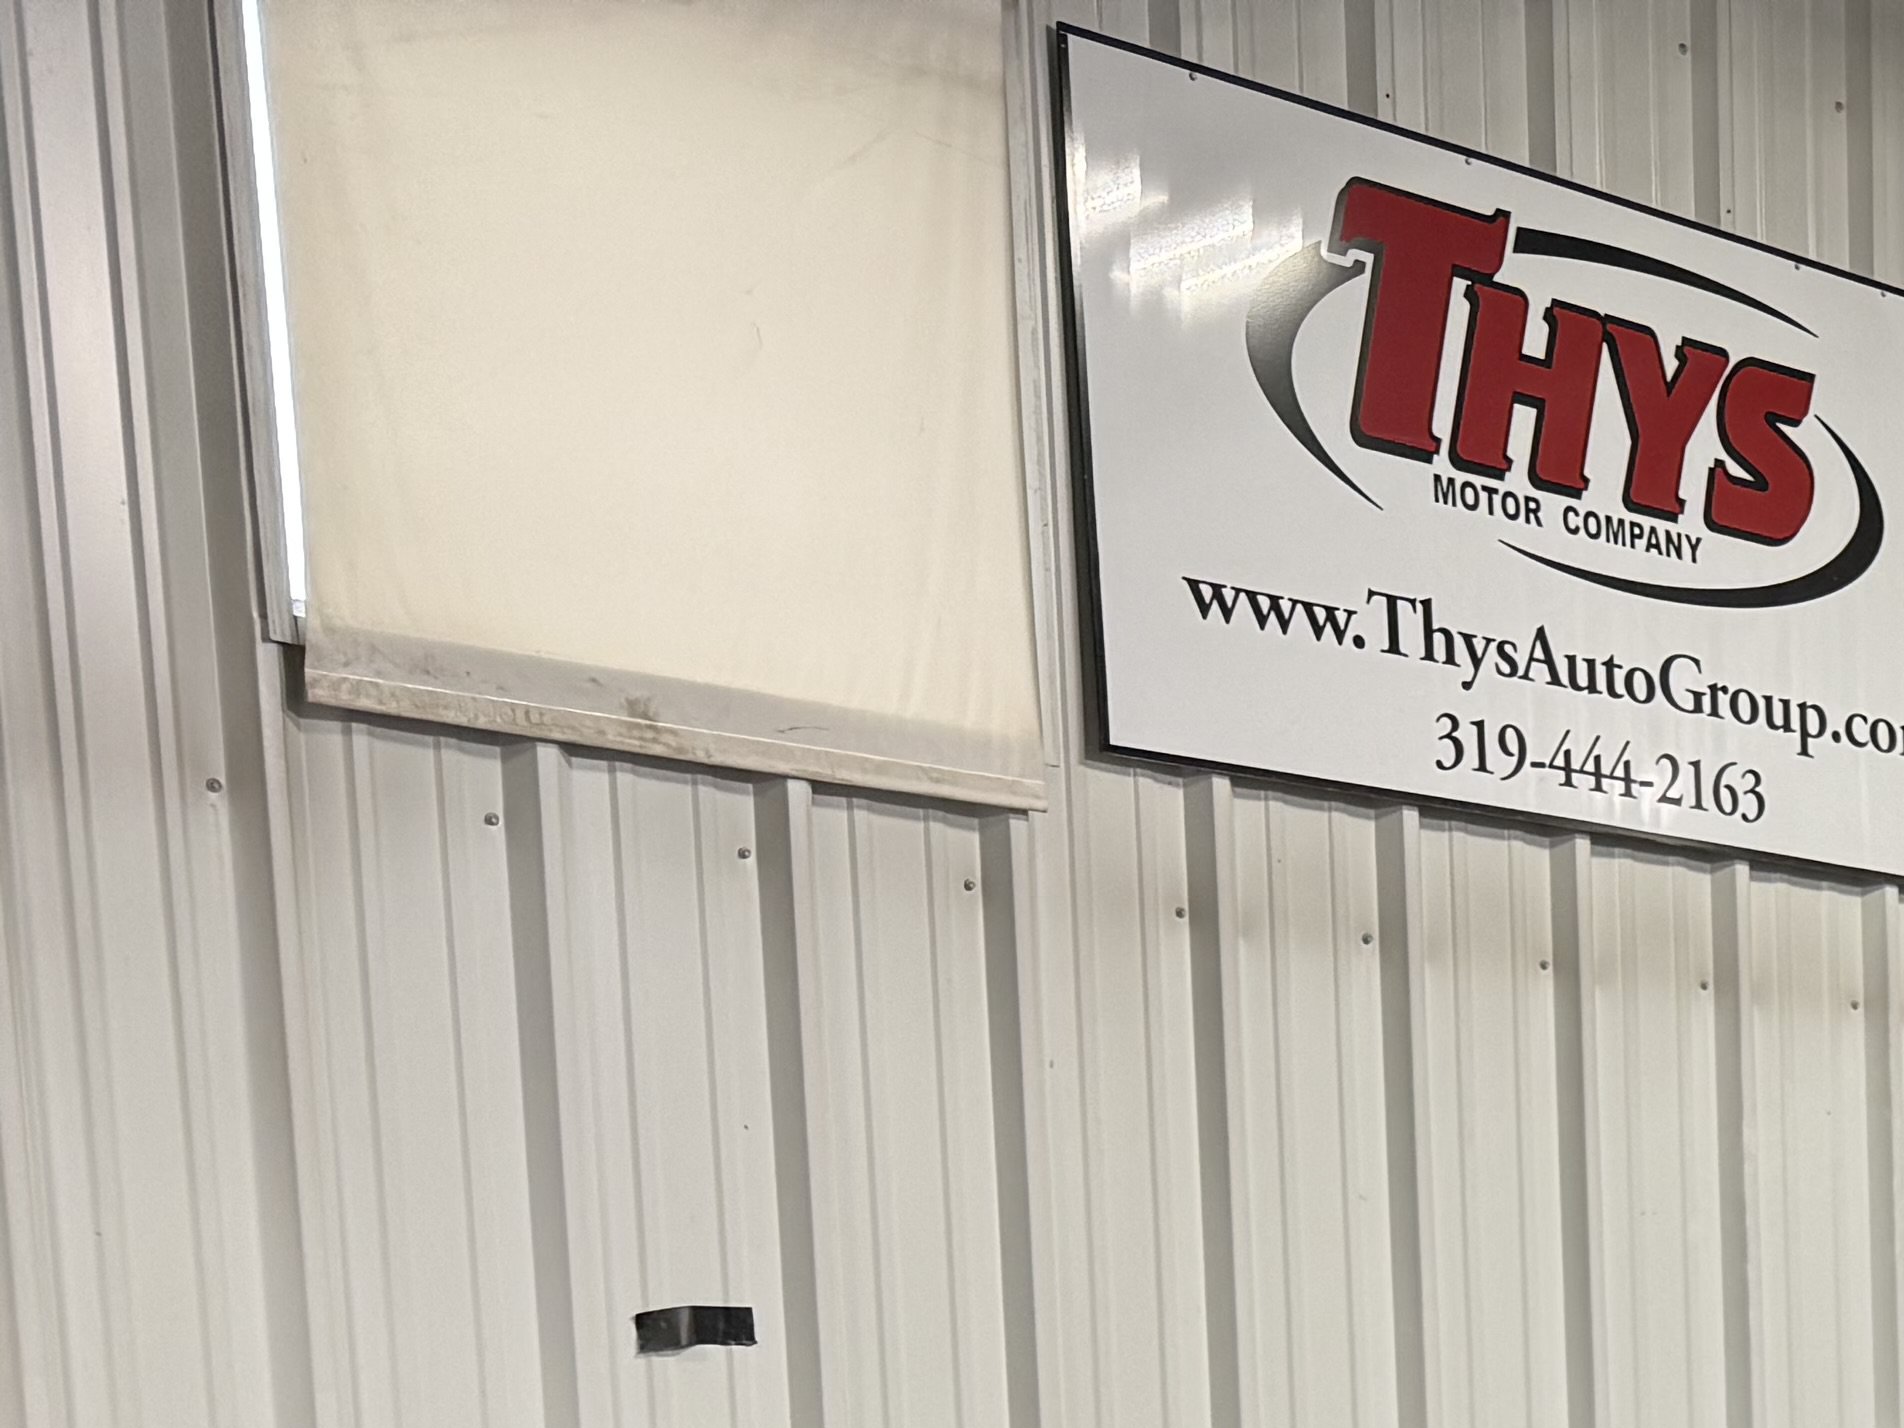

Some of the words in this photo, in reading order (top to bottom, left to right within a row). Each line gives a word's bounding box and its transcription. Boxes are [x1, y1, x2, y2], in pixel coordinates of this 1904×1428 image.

[1331, 176, 1816, 546] THYS
[1433, 475, 1543, 527] MOTOR
[1562, 505, 1702, 563] COMPANY
[1434, 713, 1766, 822] 319-444-2163
